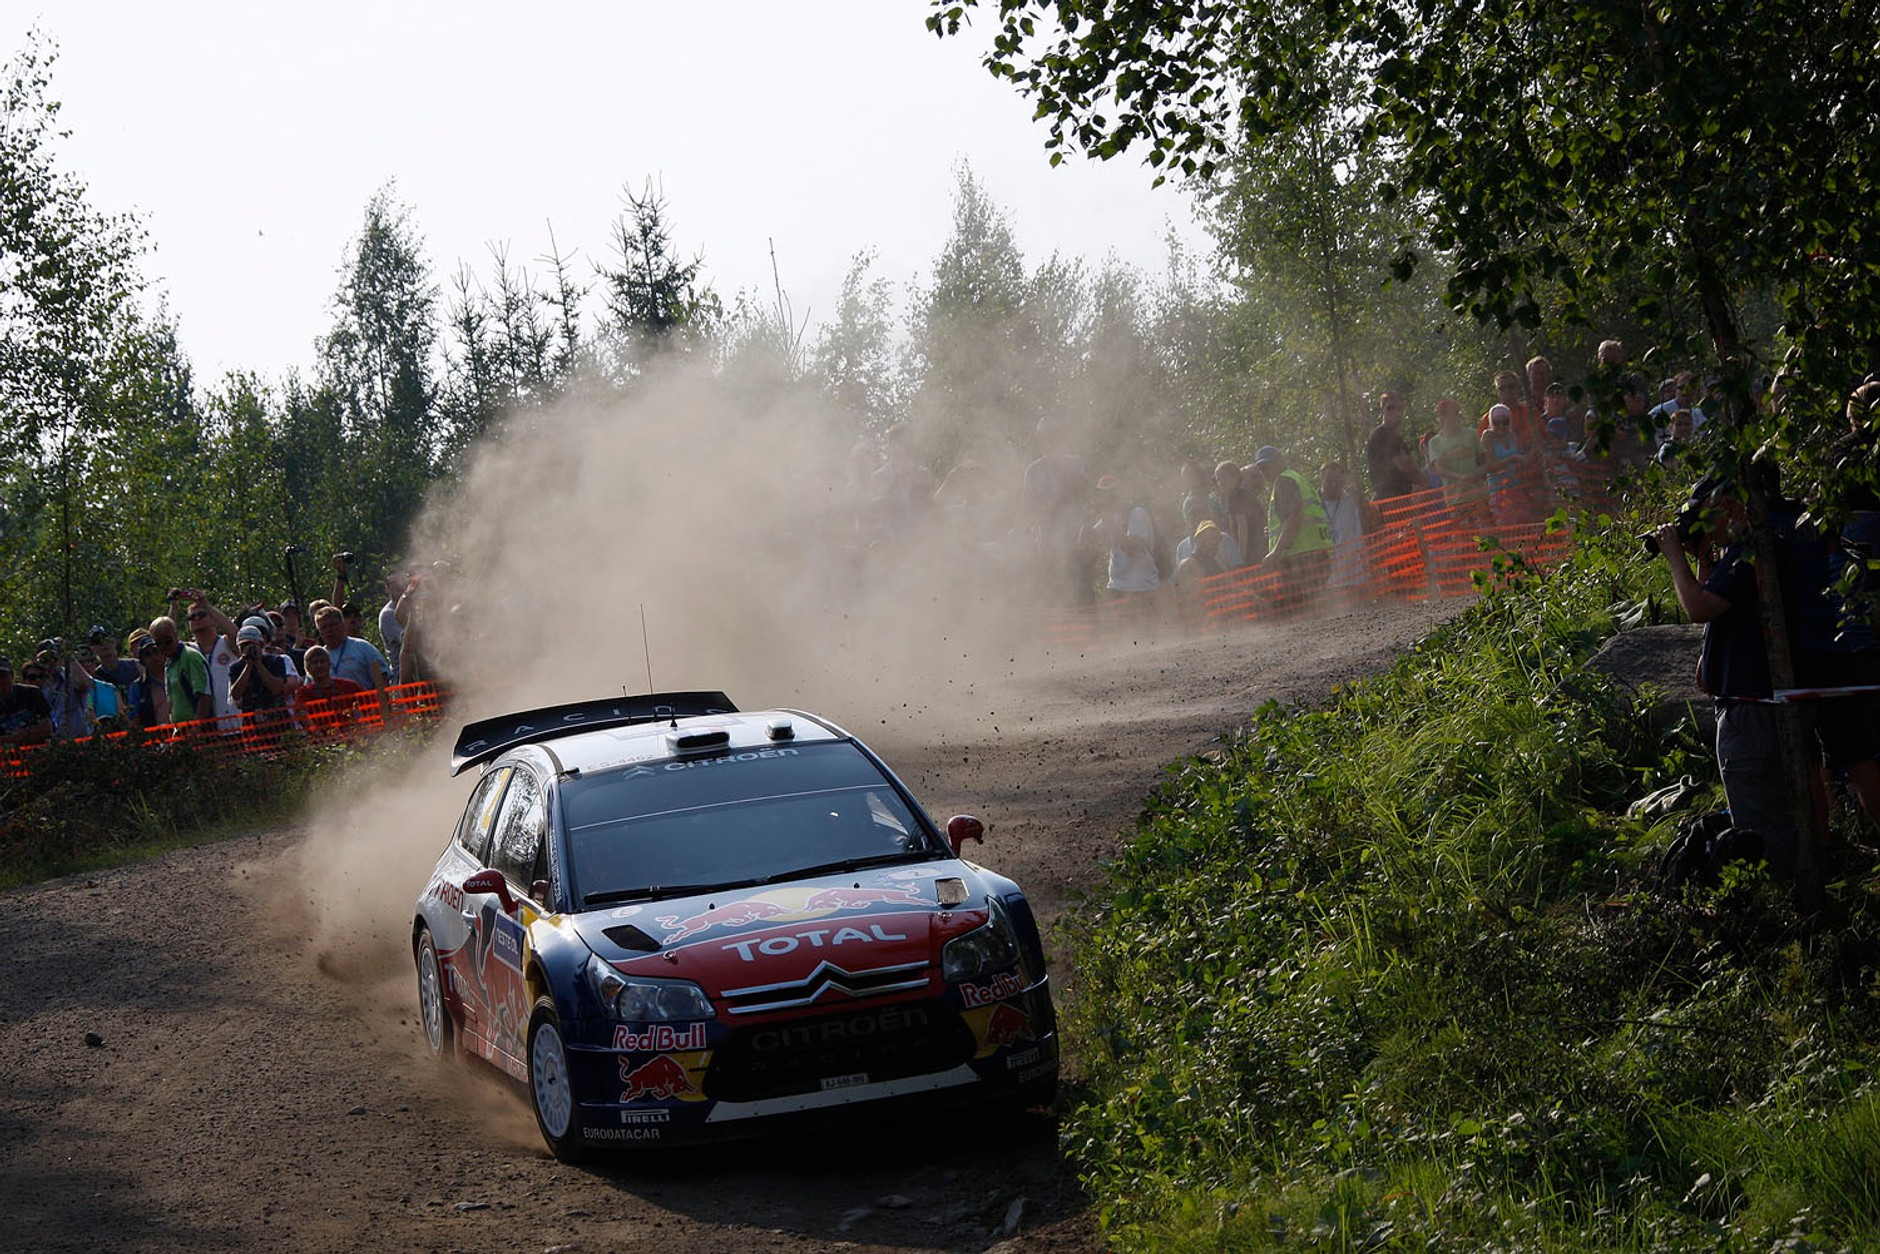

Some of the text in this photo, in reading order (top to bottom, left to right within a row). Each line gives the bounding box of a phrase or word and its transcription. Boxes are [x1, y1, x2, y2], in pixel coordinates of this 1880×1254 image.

[466, 880, 493, 888] TOTAL
[722, 924, 907, 962] TOTAL
[959, 974, 1006, 1008] Red
[612, 1022, 707, 1051] Red Bull
[621, 1108, 670, 1124] PIRELLI
[582, 1126, 660, 1140] EURODATACAR
